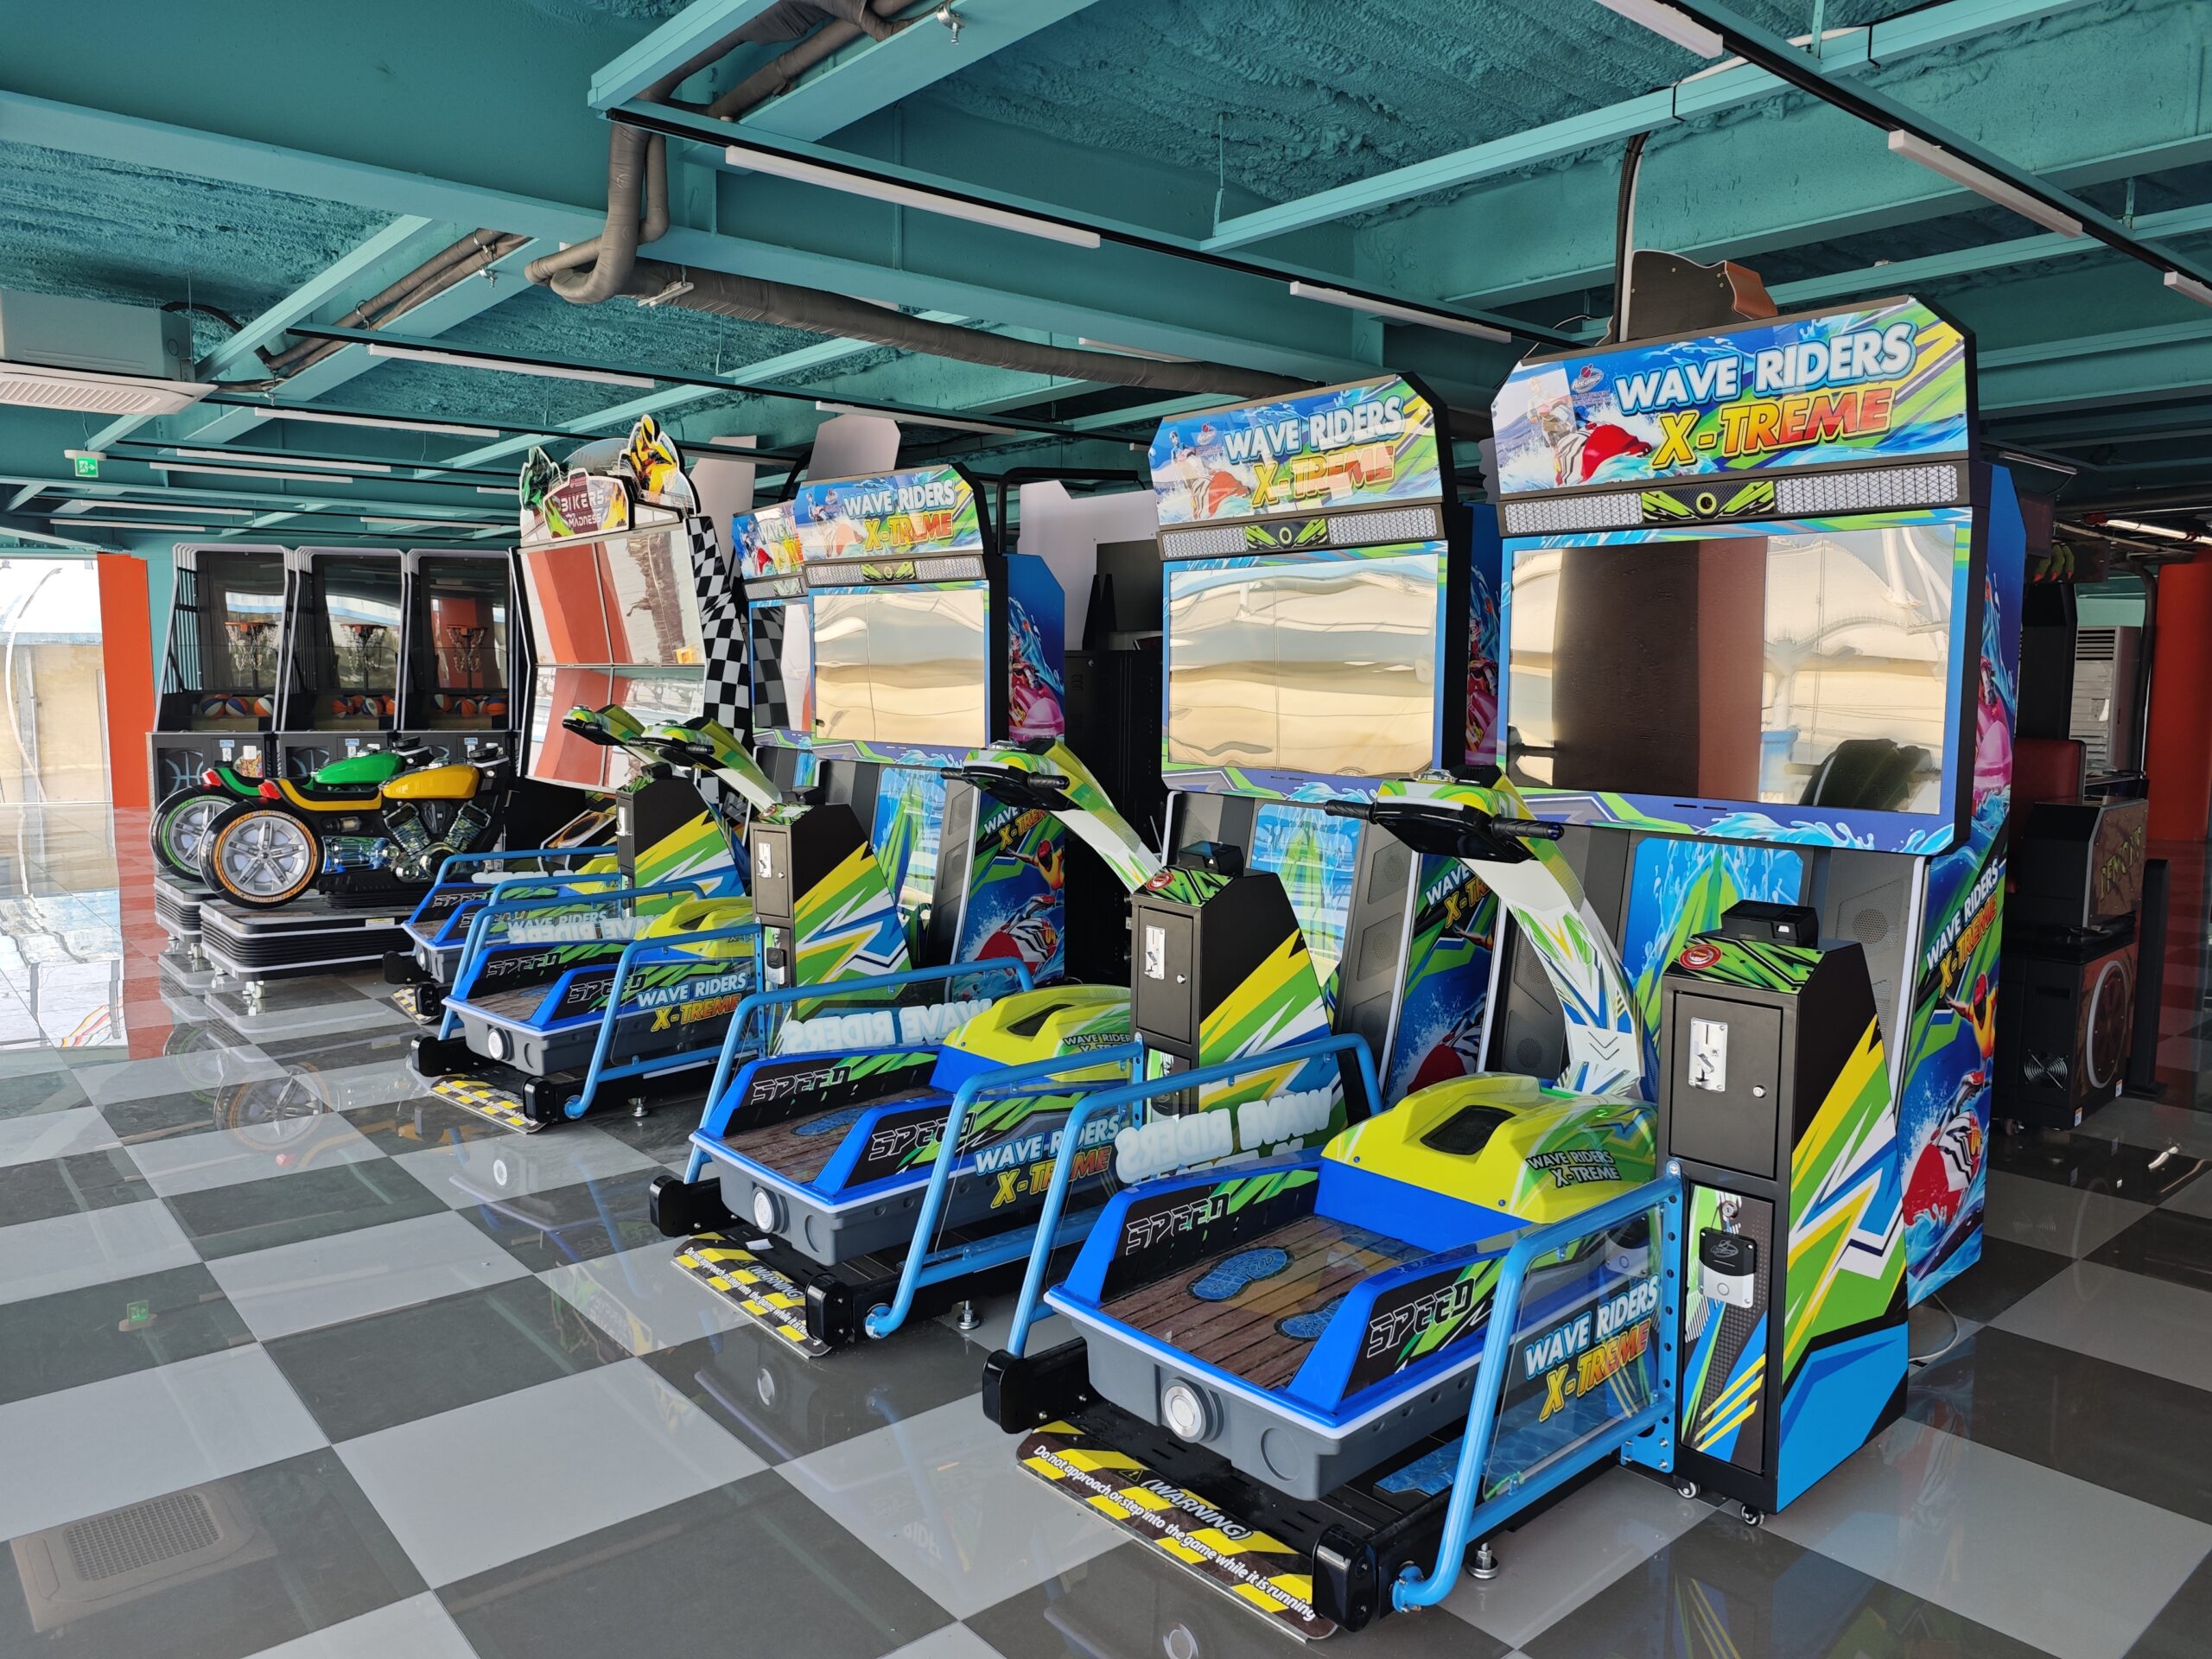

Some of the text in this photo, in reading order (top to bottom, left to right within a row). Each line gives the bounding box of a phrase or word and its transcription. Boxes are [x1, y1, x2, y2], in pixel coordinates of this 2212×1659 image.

[1614, 322, 1917, 415] WAVE RIDERS
[1224, 396, 1405, 464] WAVE RIDERS
[1651, 388, 1895, 470] X-TREME
[560, 488, 604, 512] BIKERS
[843, 479, 957, 519] WAVE RIDERS
[1252, 446, 1395, 508] X-TREME
[568, 513, 602, 528] MADNESS
[865, 512, 954, 551] X-TREME
[983, 805, 1019, 835] WAVE
[1426, 864, 1471, 907] WAVE
[1444, 875, 1491, 929] X-TR
[1927, 855, 1999, 974] WAVE RIDERS
[486, 951, 562, 978] SPEED
[1939, 891, 1998, 999] X-TREME
[637, 971, 749, 1009] WAVE RIDERS
[1063, 1033, 1131, 1046] WAVE RIDER
[751, 1065, 853, 1105] SPEED
[974, 1113, 1122, 1176] WAVE RERS
[1526, 1149, 1616, 1170] WAVE RIDERS
[990, 1146, 1112, 1209] X-TRME
[1549, 1165, 1622, 1188] X-TREME
[1125, 1191, 1231, 1256] SPEED
[1366, 1276, 1476, 1358] SPEED
[1524, 1272, 1661, 1380] WAVE RIDERS
[1539, 1318, 1651, 1422] X-TREME
[1033, 1445, 1317, 1623] Do not approach or step into the game while it is running
